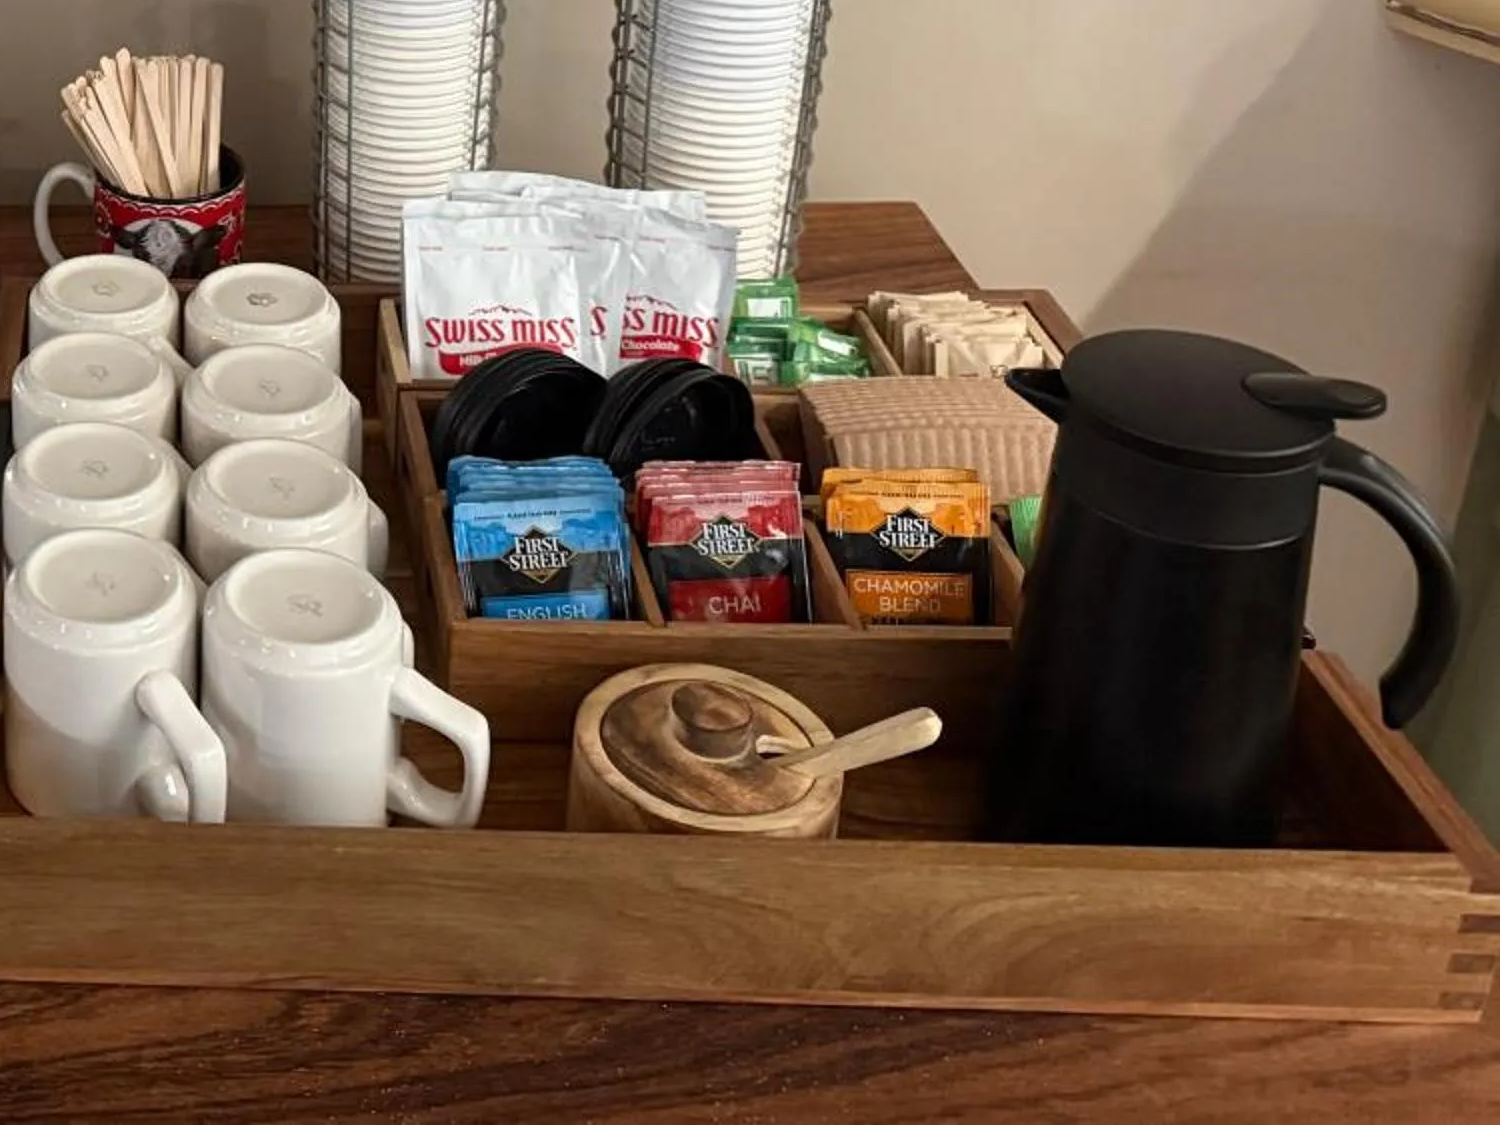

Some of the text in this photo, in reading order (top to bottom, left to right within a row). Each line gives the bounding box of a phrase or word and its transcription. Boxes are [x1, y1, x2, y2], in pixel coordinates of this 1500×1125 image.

[425, 317, 505, 348] SWISS
[511, 317, 576, 348] MISS
[702, 522, 747, 540] FIRST
[886, 514, 931, 533] FIRST
[515, 535, 559, 555] FIRST
[697, 537, 760, 556] STREET
[879, 529, 937, 549] STREET
[509, 550, 569, 572] STREET
[853, 578, 965, 598] CHAMOMILE
[707, 591, 762, 615] CHAI
[879, 596, 941, 614] BLEND
